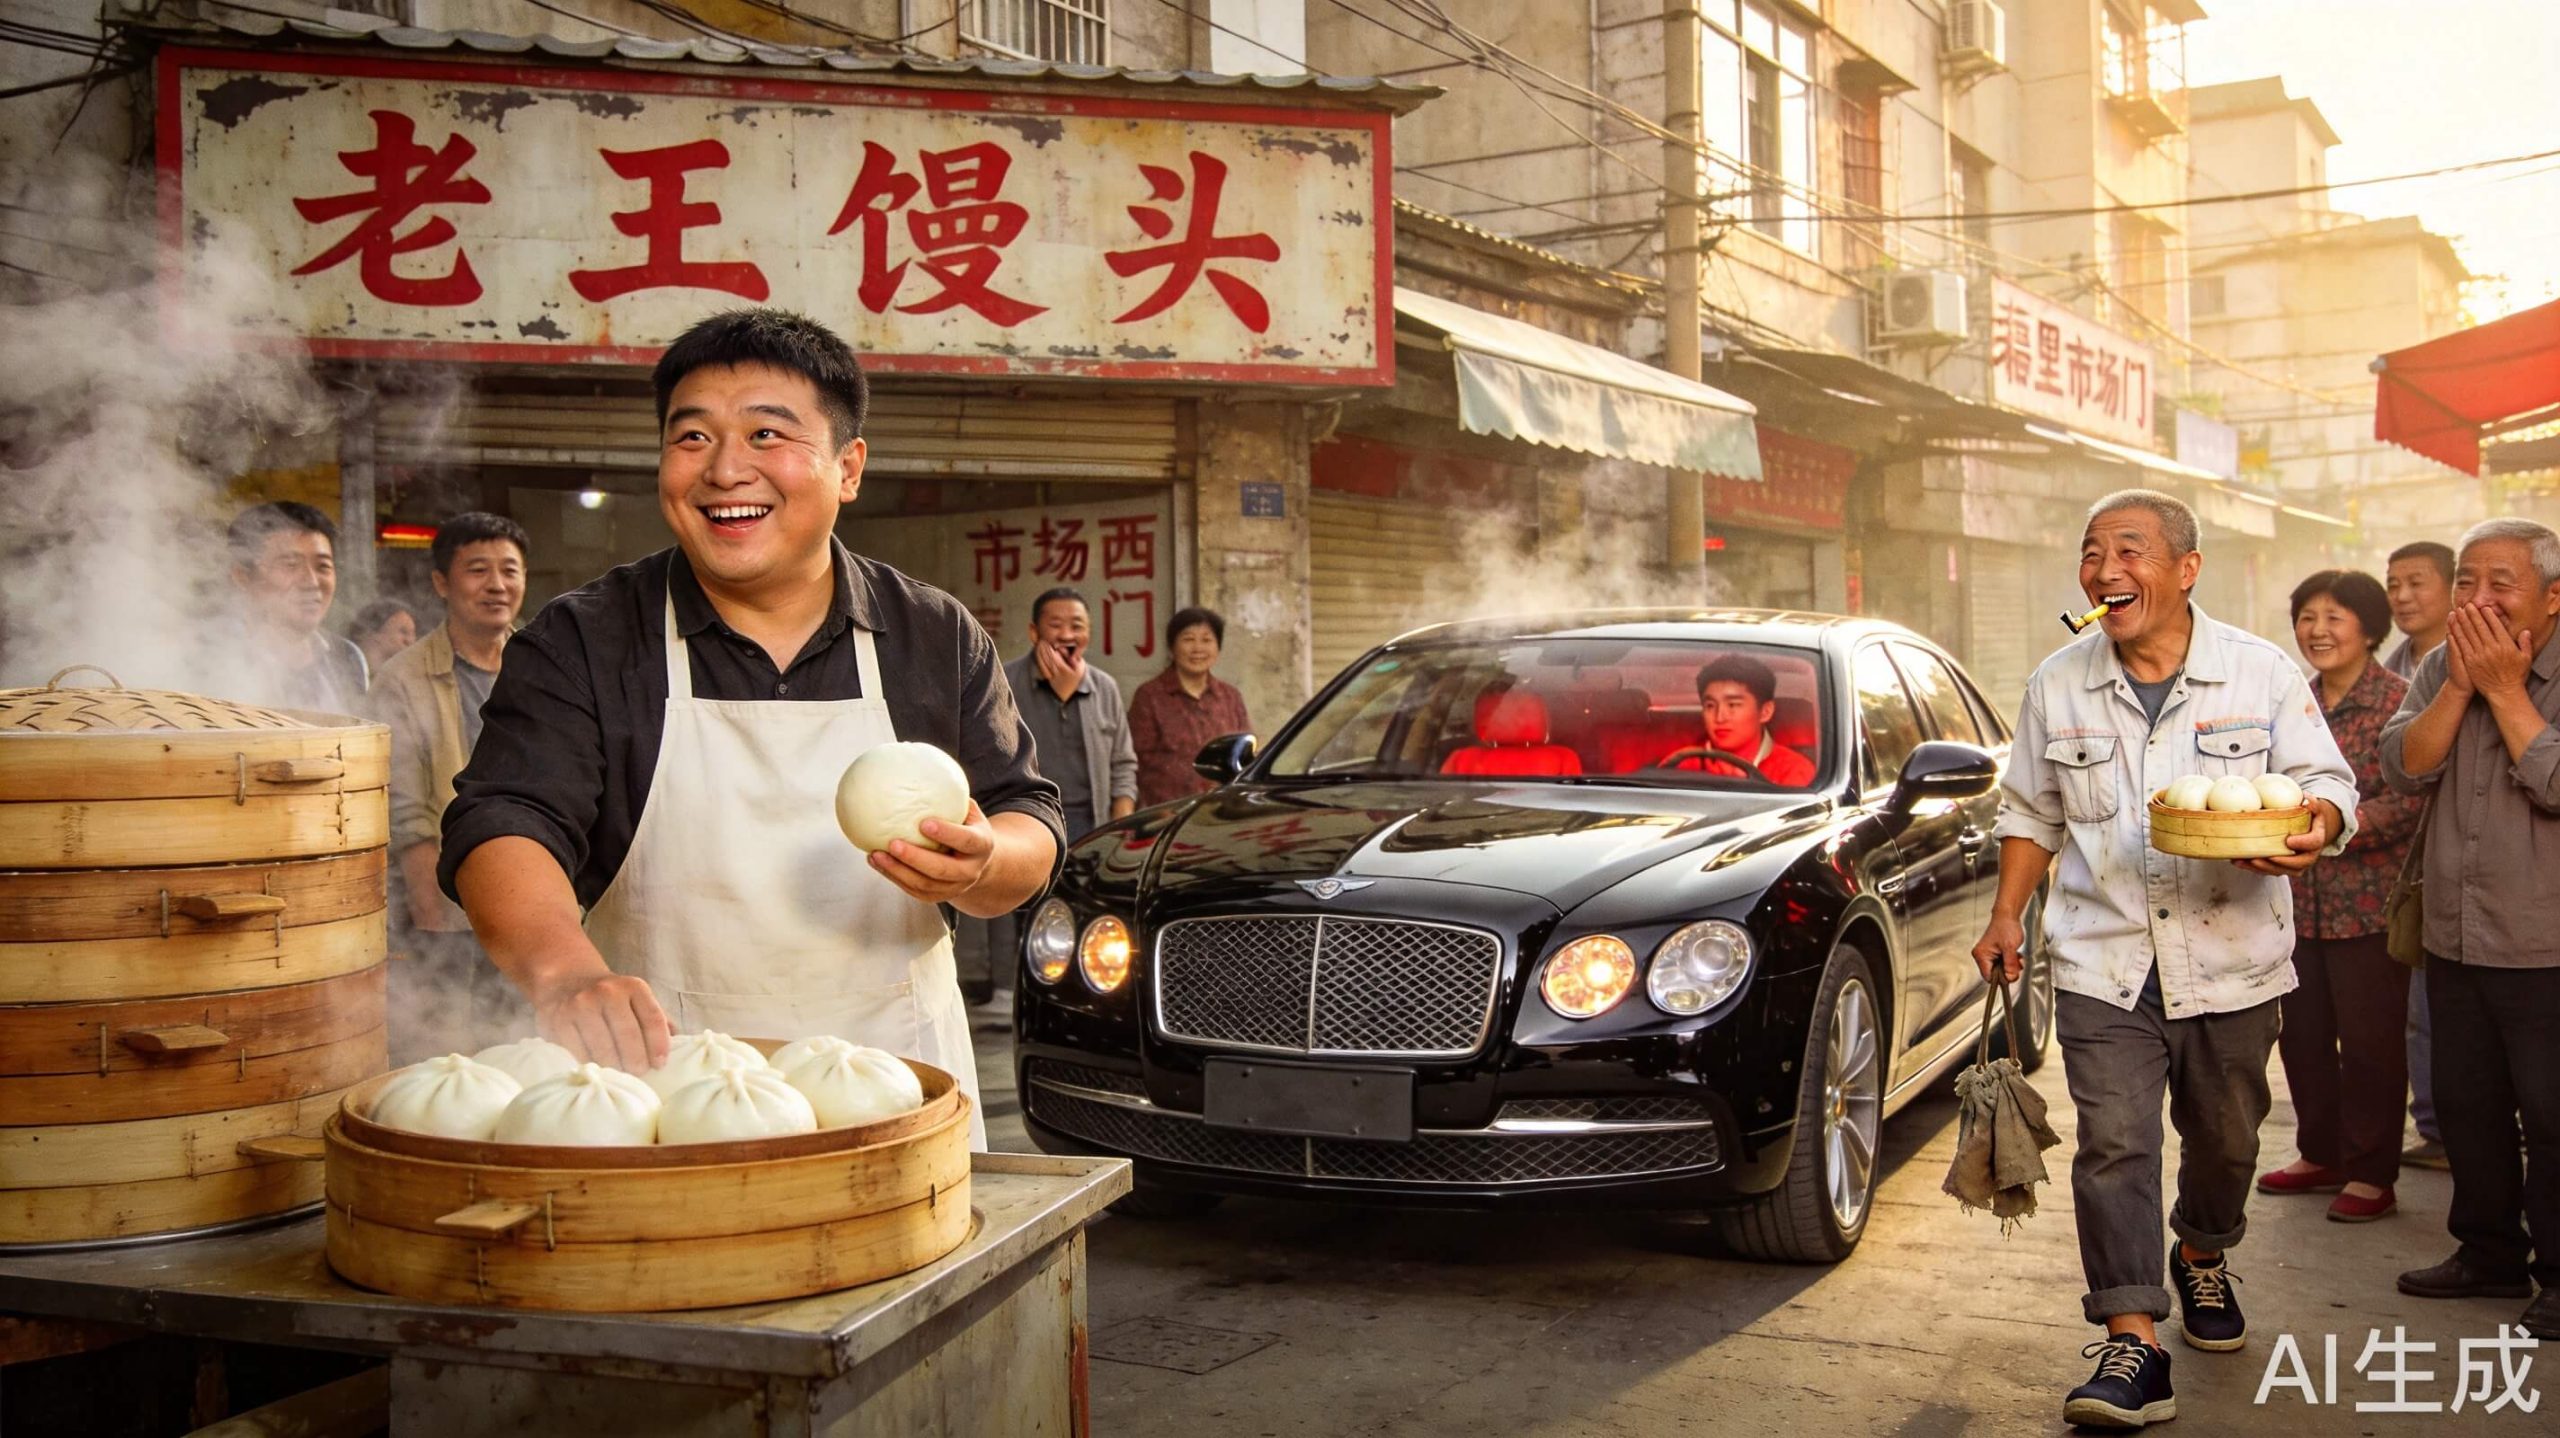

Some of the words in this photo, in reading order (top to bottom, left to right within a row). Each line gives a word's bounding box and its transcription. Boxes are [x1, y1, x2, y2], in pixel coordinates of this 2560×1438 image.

[291, 110, 1281, 334] 老王馒头
[966, 514, 1157, 592] 市场西
